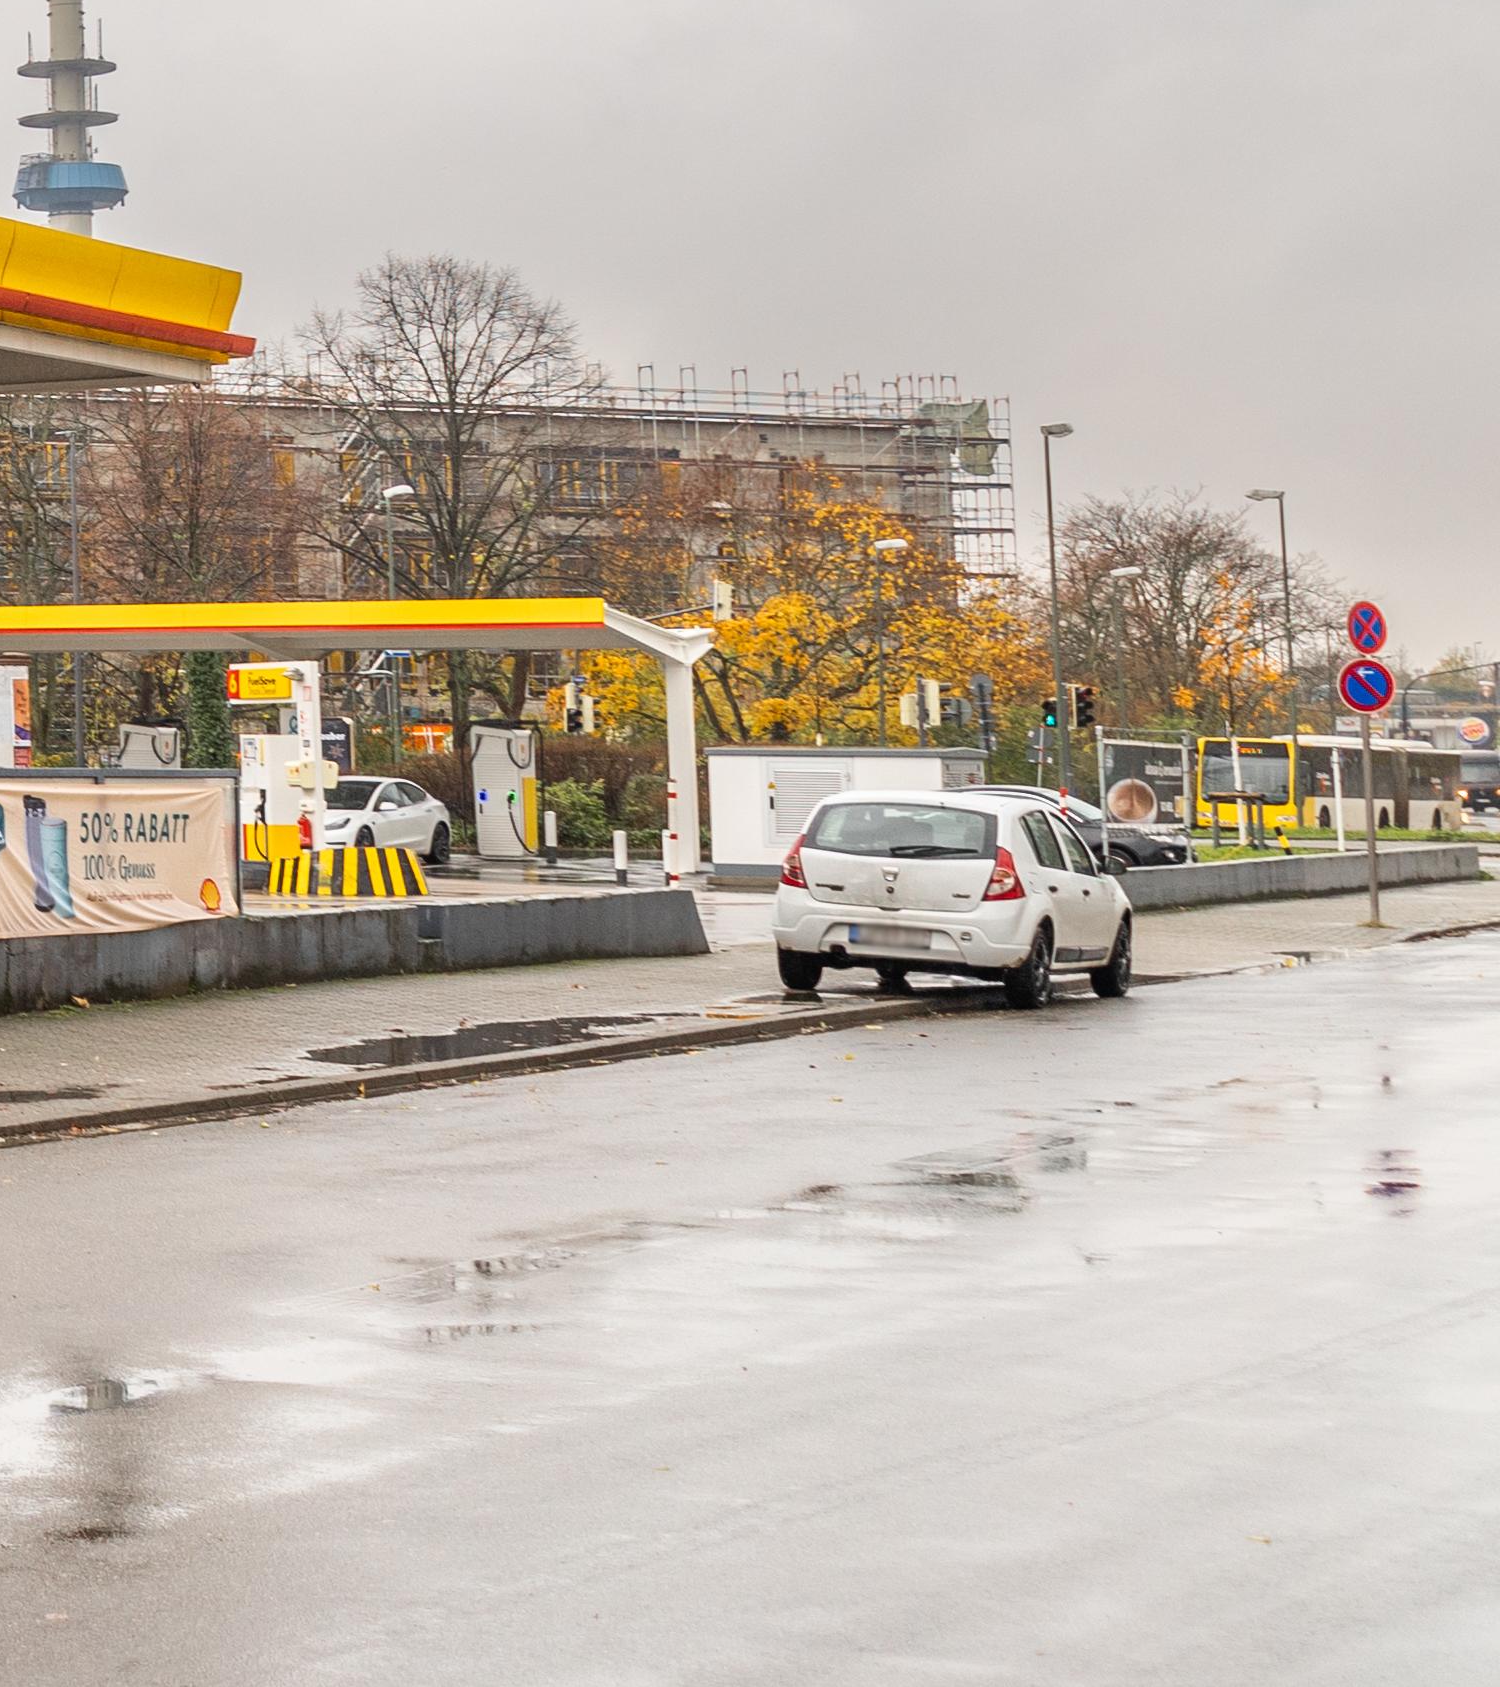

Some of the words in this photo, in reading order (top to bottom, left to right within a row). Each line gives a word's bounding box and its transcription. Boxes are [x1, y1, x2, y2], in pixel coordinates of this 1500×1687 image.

[228, 673, 238, 694] 6
[79, 812, 119, 844] 50%
[123, 812, 190, 844] RABATT
[118, 854, 156, 882] Genuss
